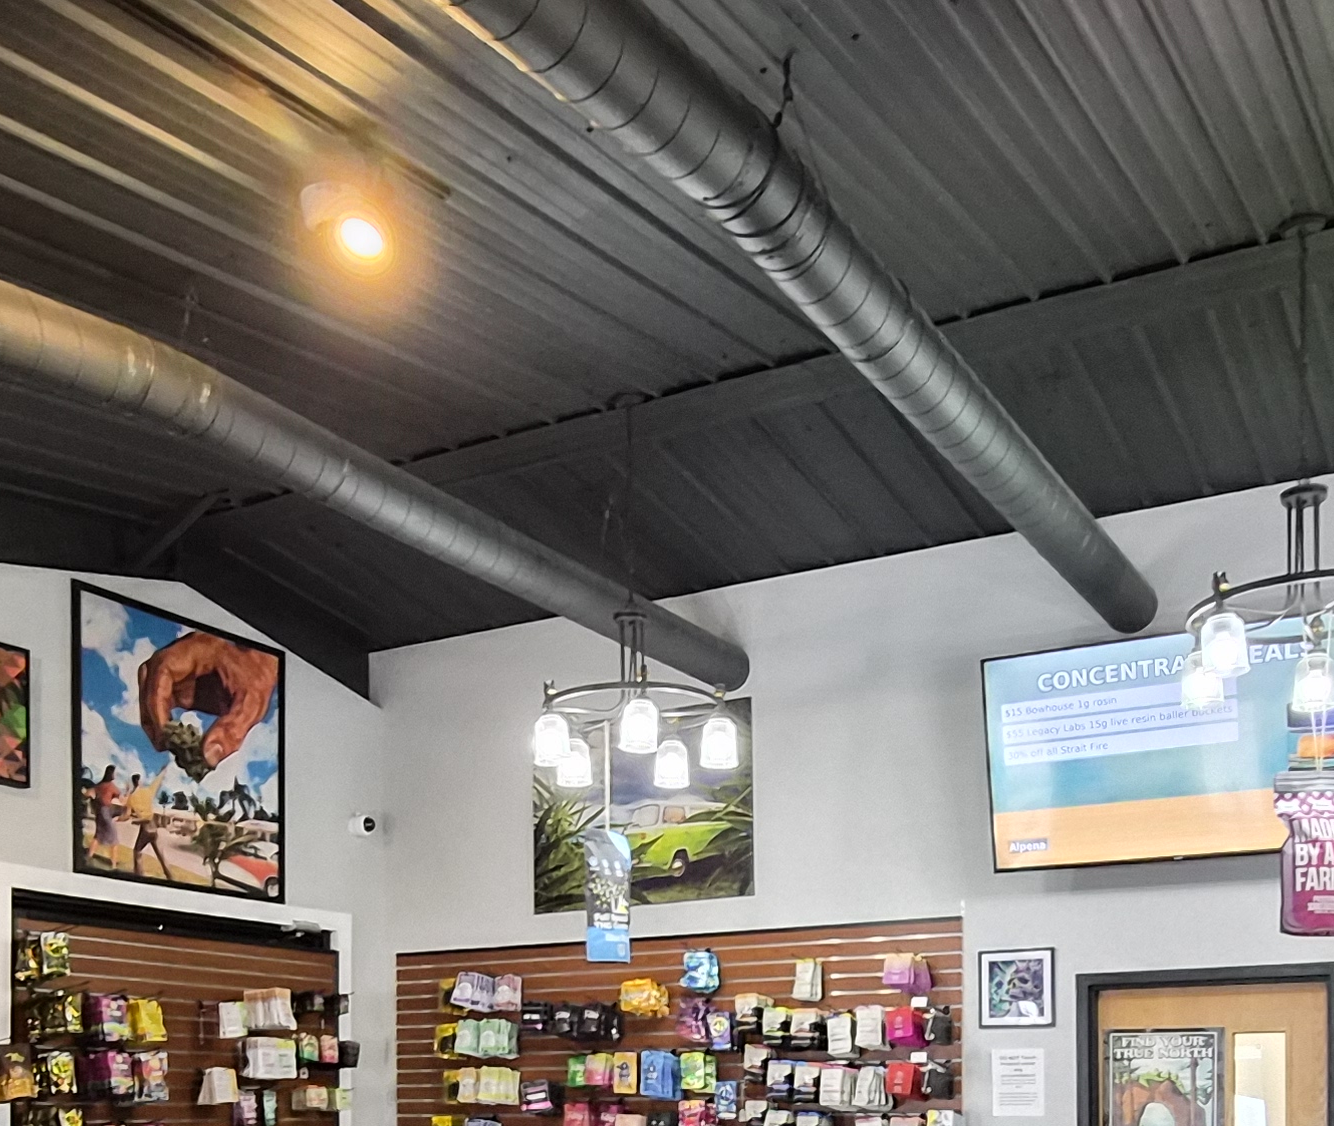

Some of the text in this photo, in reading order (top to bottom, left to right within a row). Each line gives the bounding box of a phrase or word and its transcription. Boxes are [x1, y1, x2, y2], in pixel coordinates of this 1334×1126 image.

[1037, 641, 1315, 693] CONCENTRA EALS
[1078, 700, 1090, 710] 1g
[1093, 696, 1117, 707] rosin
[1027, 725, 1060, 738] Legacy
[1063, 721, 1086, 733] Labs
[1089, 719, 1108, 731] 15g
[1110, 717, 1128, 727] live
[1131, 714, 1156, 724] resin
[1159, 710, 1188, 721] baller
[1060, 743, 1087, 755] Strait
[1009, 841, 1047, 853] Alpena
[1295, 842, 1321, 866] BY
[1121, 1036, 1205, 1048] FIND YOUR
[1113, 1047, 1213, 1059] TRUE NORTH
